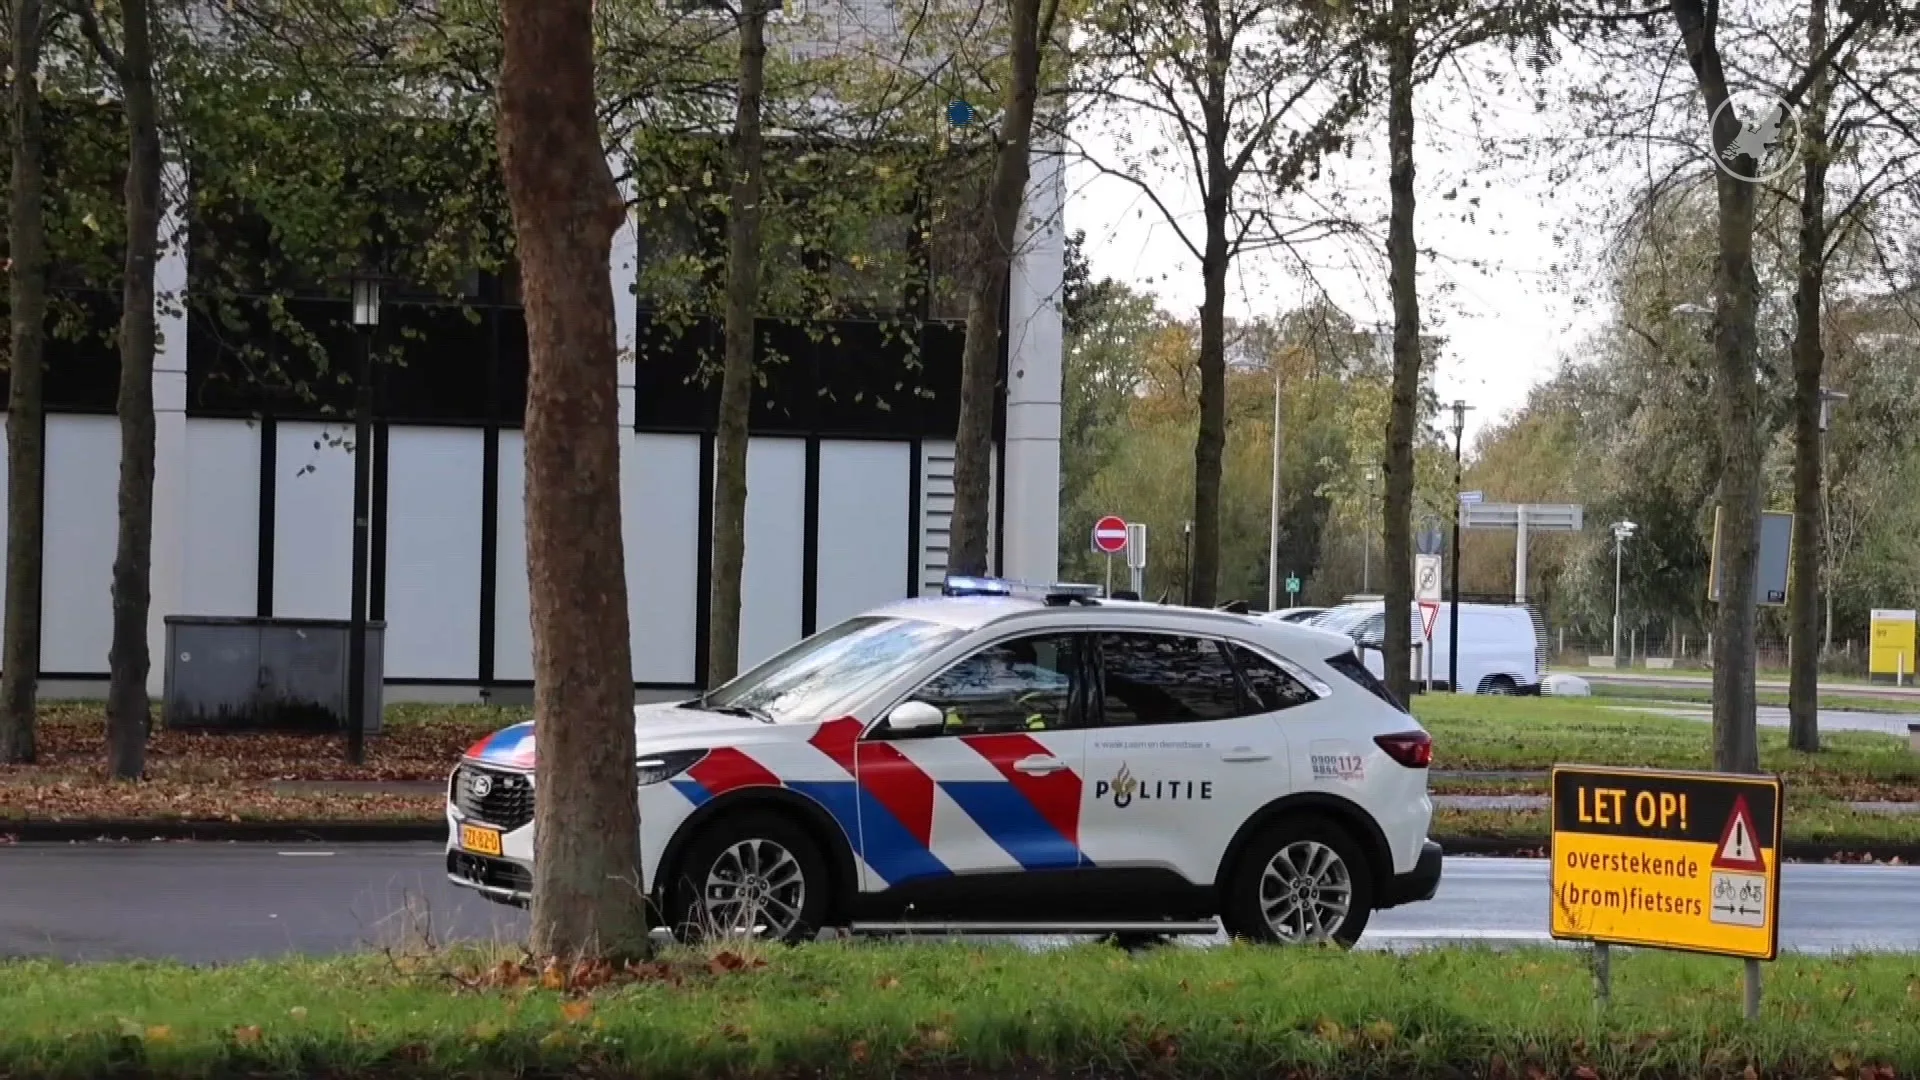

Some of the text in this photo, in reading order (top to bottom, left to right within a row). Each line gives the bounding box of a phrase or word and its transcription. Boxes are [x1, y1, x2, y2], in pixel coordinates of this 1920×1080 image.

[1311, 755, 1336, 764] 0900
[1338, 755, 1363, 771] 112
[1096, 779, 1213, 808] POLITIE
[1578, 786, 1687, 831] LET OP!
[1567, 851, 1698, 879] overstekende
[1561, 881, 1702, 915] (brom)fietsers
